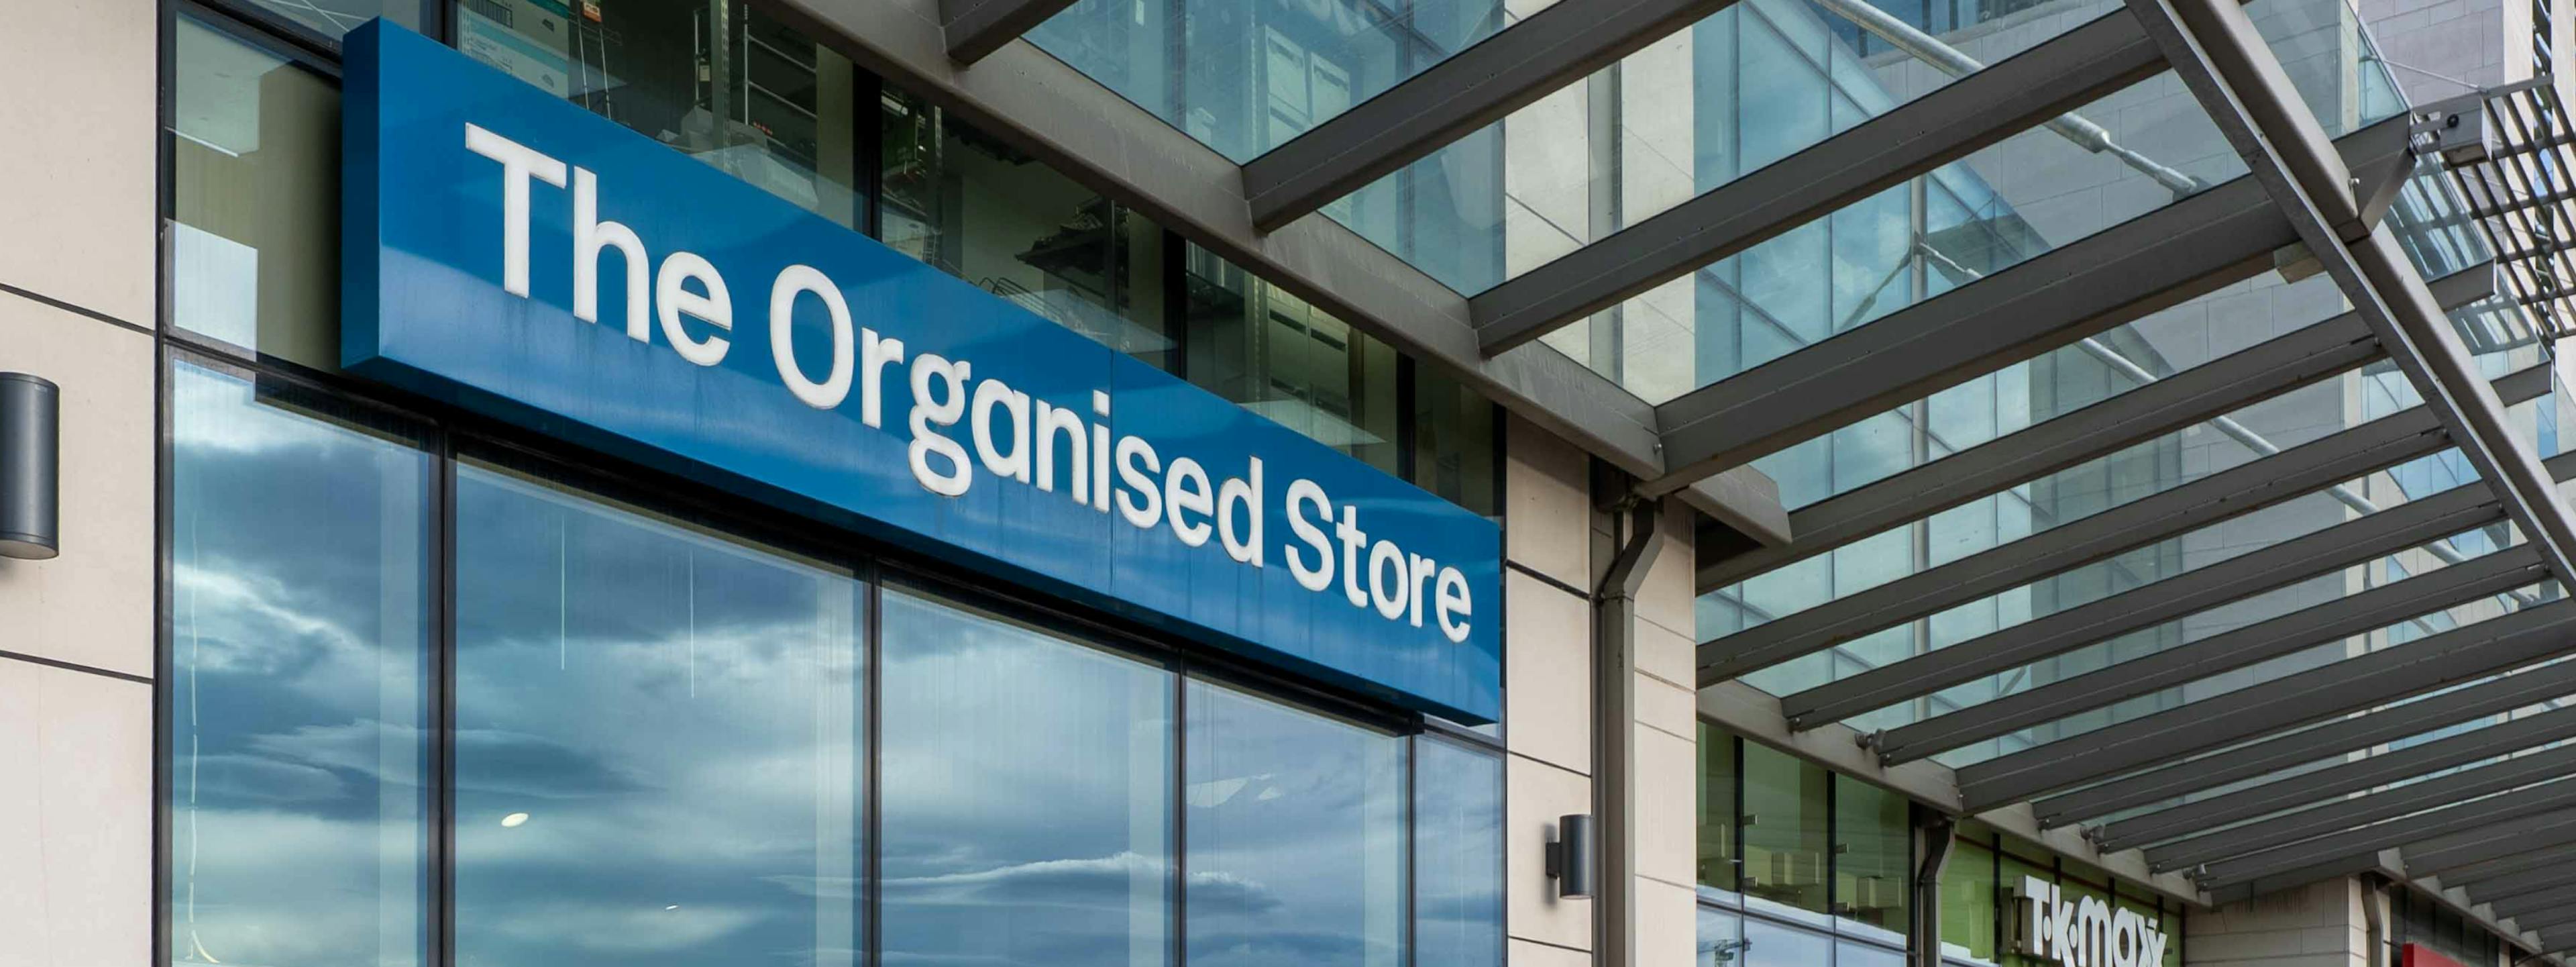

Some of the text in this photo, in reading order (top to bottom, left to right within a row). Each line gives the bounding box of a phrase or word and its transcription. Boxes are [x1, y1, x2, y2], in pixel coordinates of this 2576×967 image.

[464, 121, 1472, 643] The Organised Store
